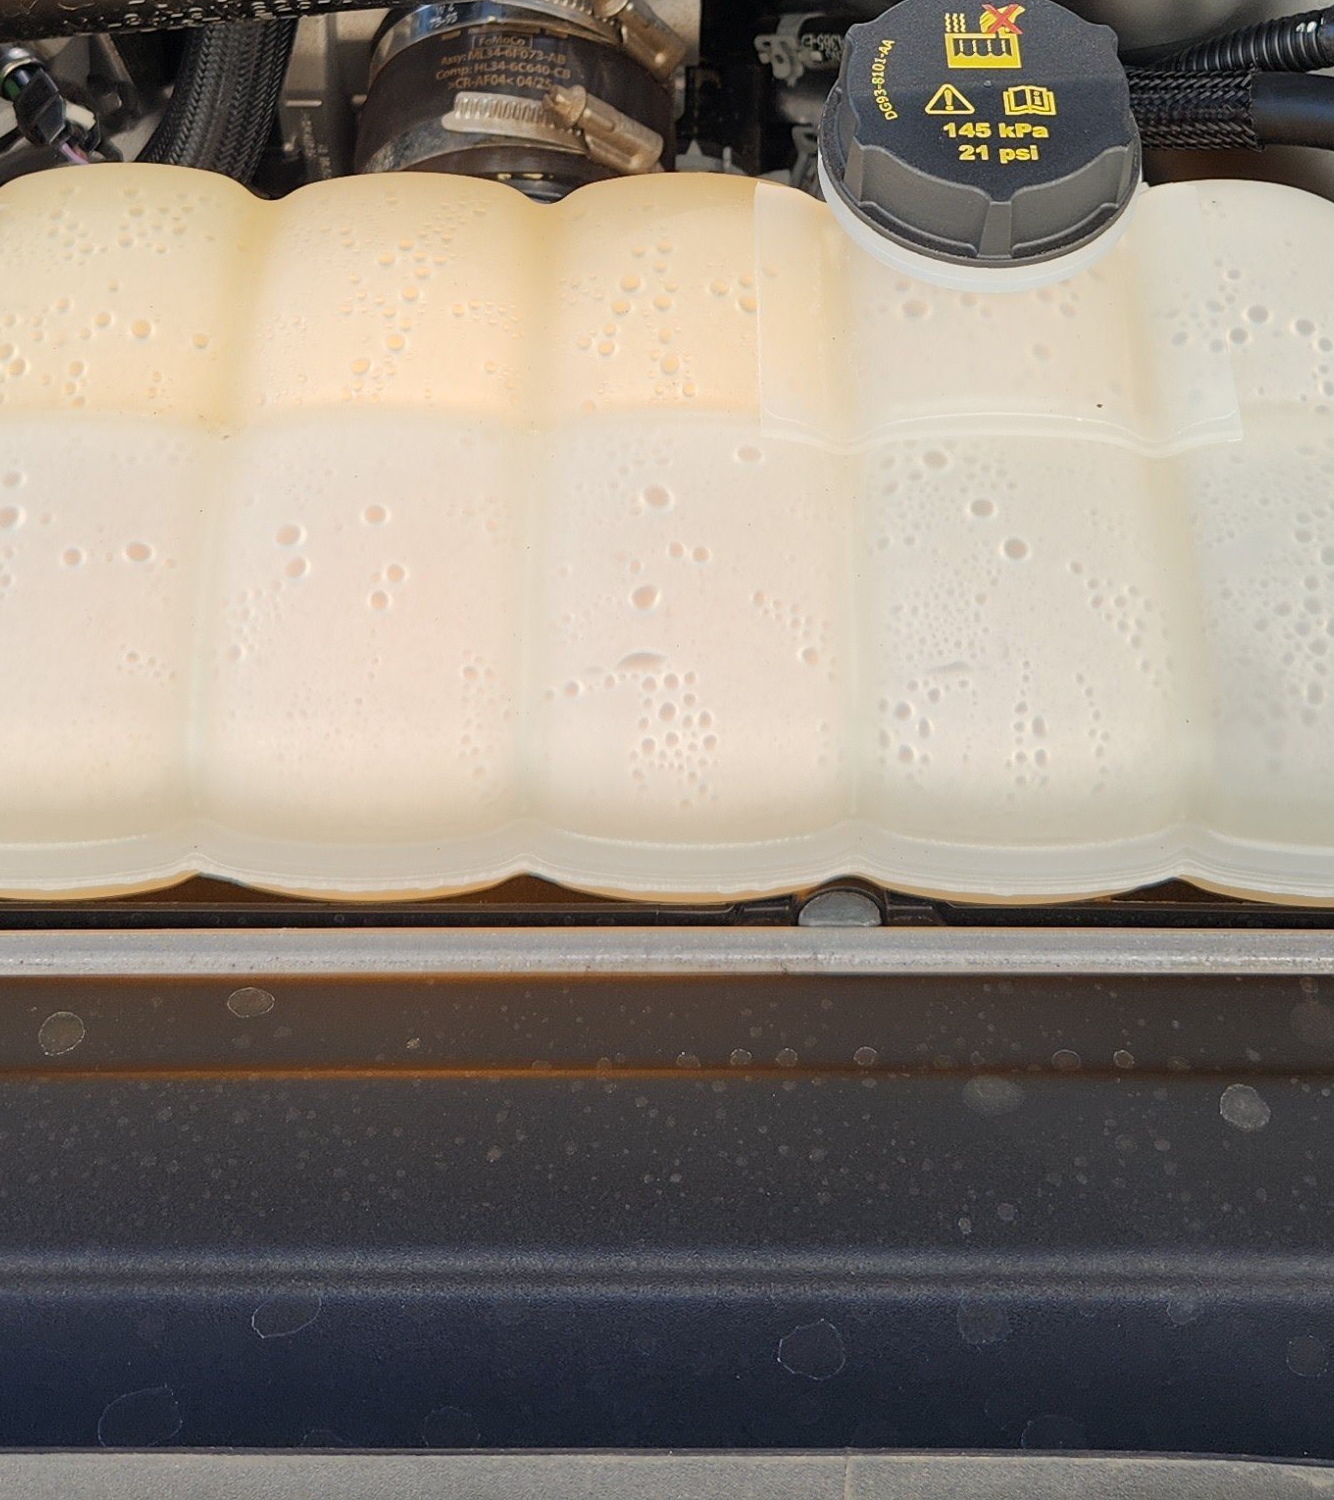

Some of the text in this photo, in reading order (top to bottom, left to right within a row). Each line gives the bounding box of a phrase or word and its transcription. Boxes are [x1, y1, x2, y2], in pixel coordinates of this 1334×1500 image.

[477, 35, 526, 47] FoMoCo
[943, 122, 1050, 138] 145 kPa
[958, 144, 1040, 164] 21 psi
